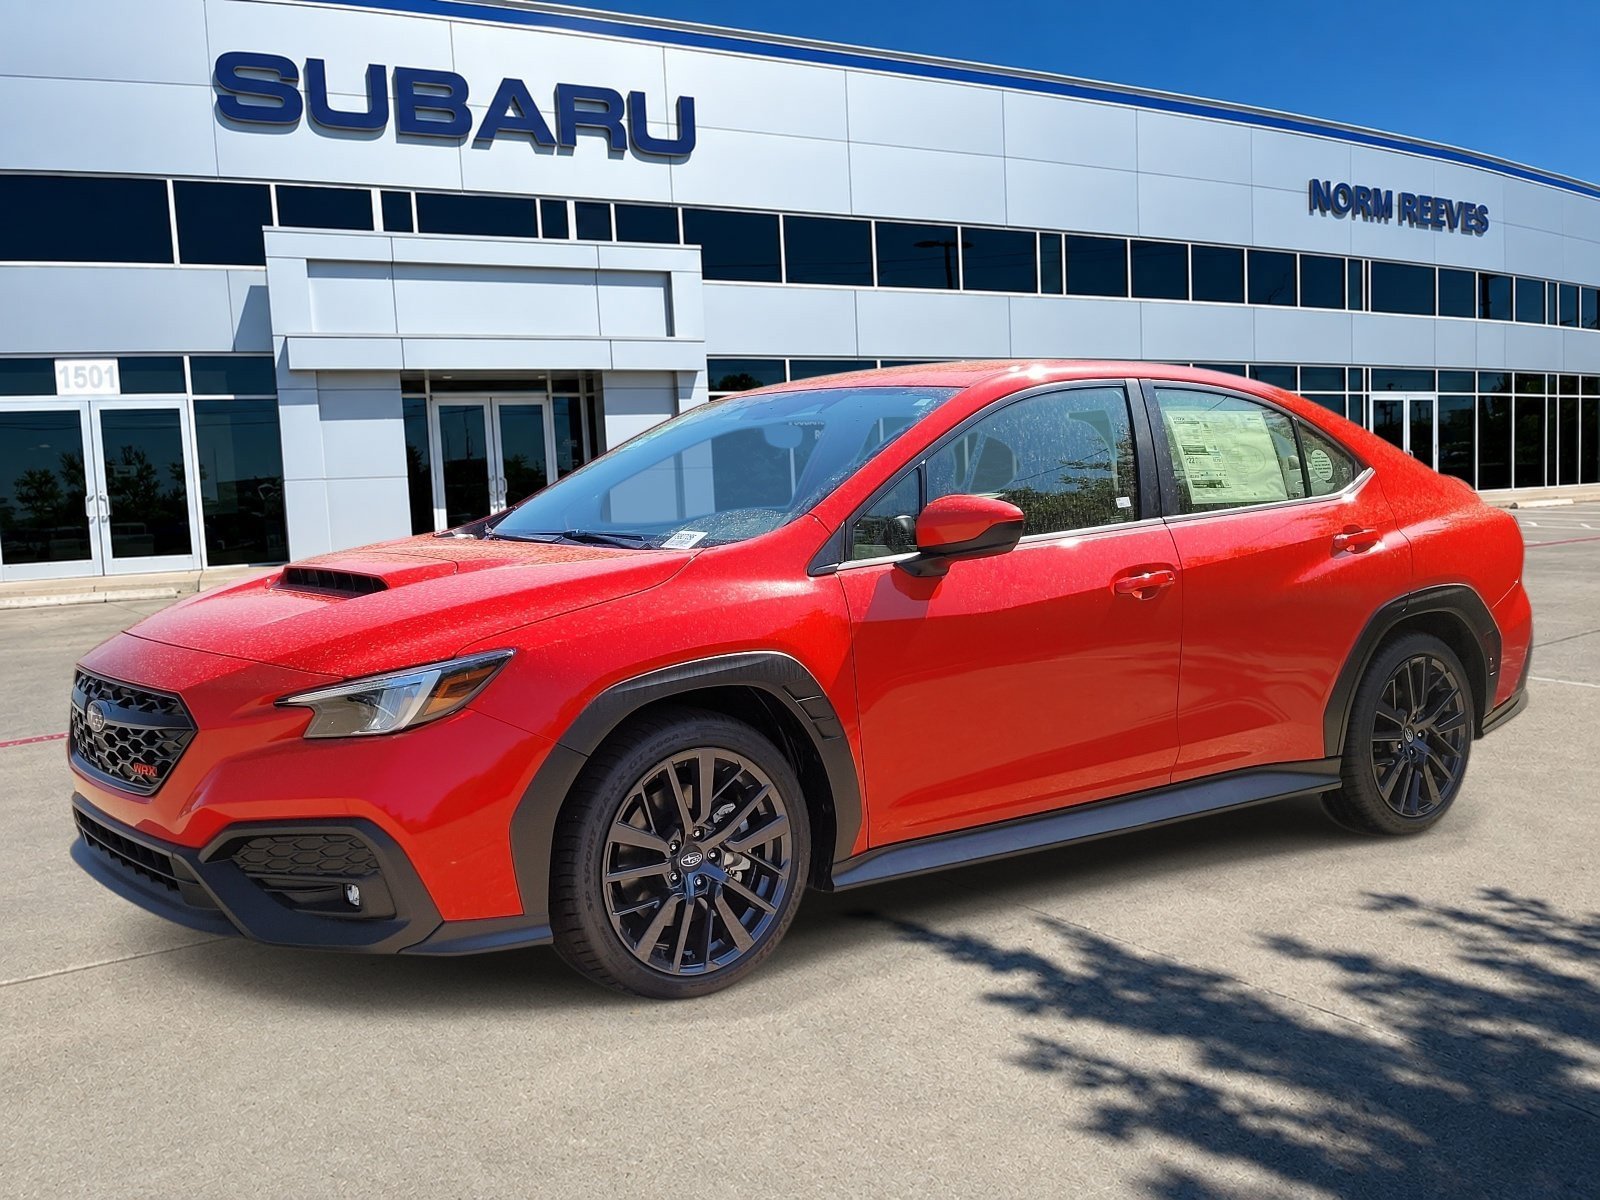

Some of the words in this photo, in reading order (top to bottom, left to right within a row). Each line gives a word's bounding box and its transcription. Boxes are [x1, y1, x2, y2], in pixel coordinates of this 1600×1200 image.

[214, 51, 696, 159] SUBARU
[1309, 178, 1393, 222] NORM
[1398, 191, 1490, 235] REEVES
[59, 365, 116, 389] 1501
[133, 763, 157, 776] WRX
